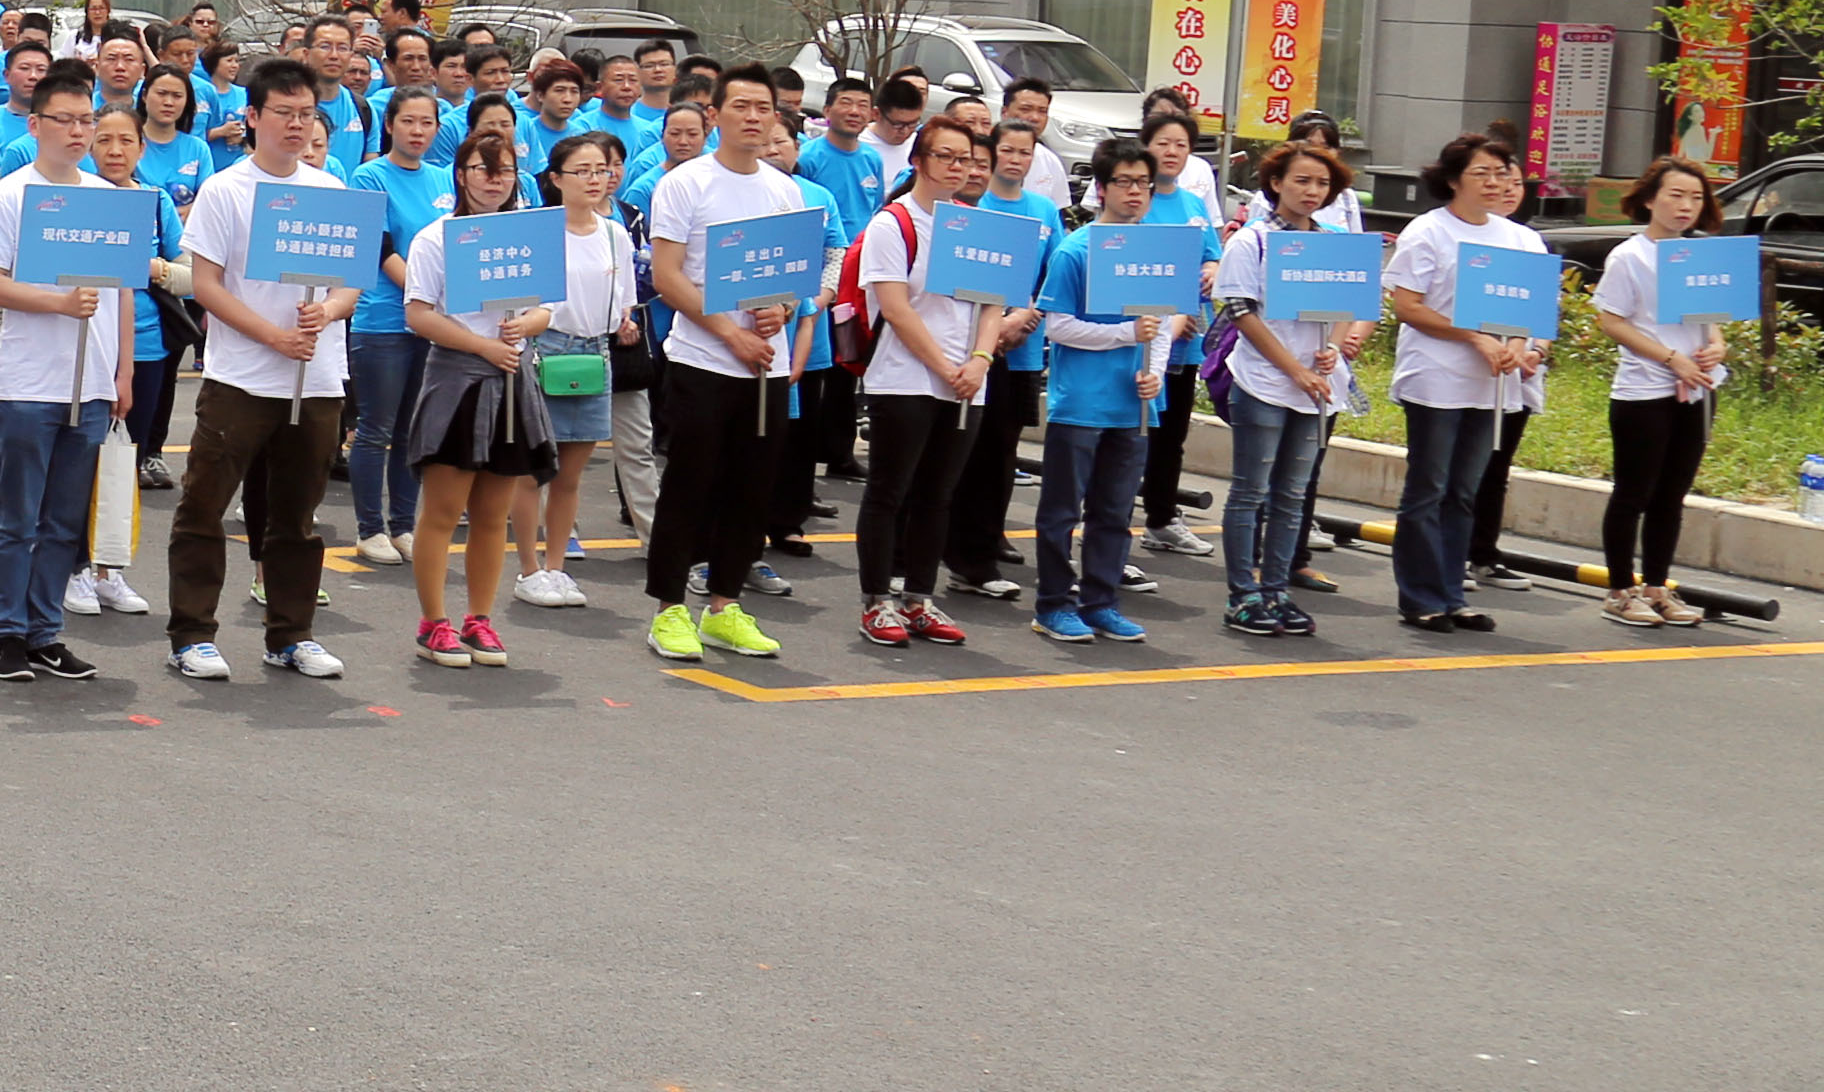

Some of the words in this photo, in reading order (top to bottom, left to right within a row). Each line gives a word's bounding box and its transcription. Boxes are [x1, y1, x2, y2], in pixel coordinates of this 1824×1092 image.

[42, 227, 131, 245] 现代交通产业园
[277, 220, 358, 240] 协通小额贷款
[275, 238, 356, 258] 协通融资担保
[479, 244, 532, 262] 经济中心
